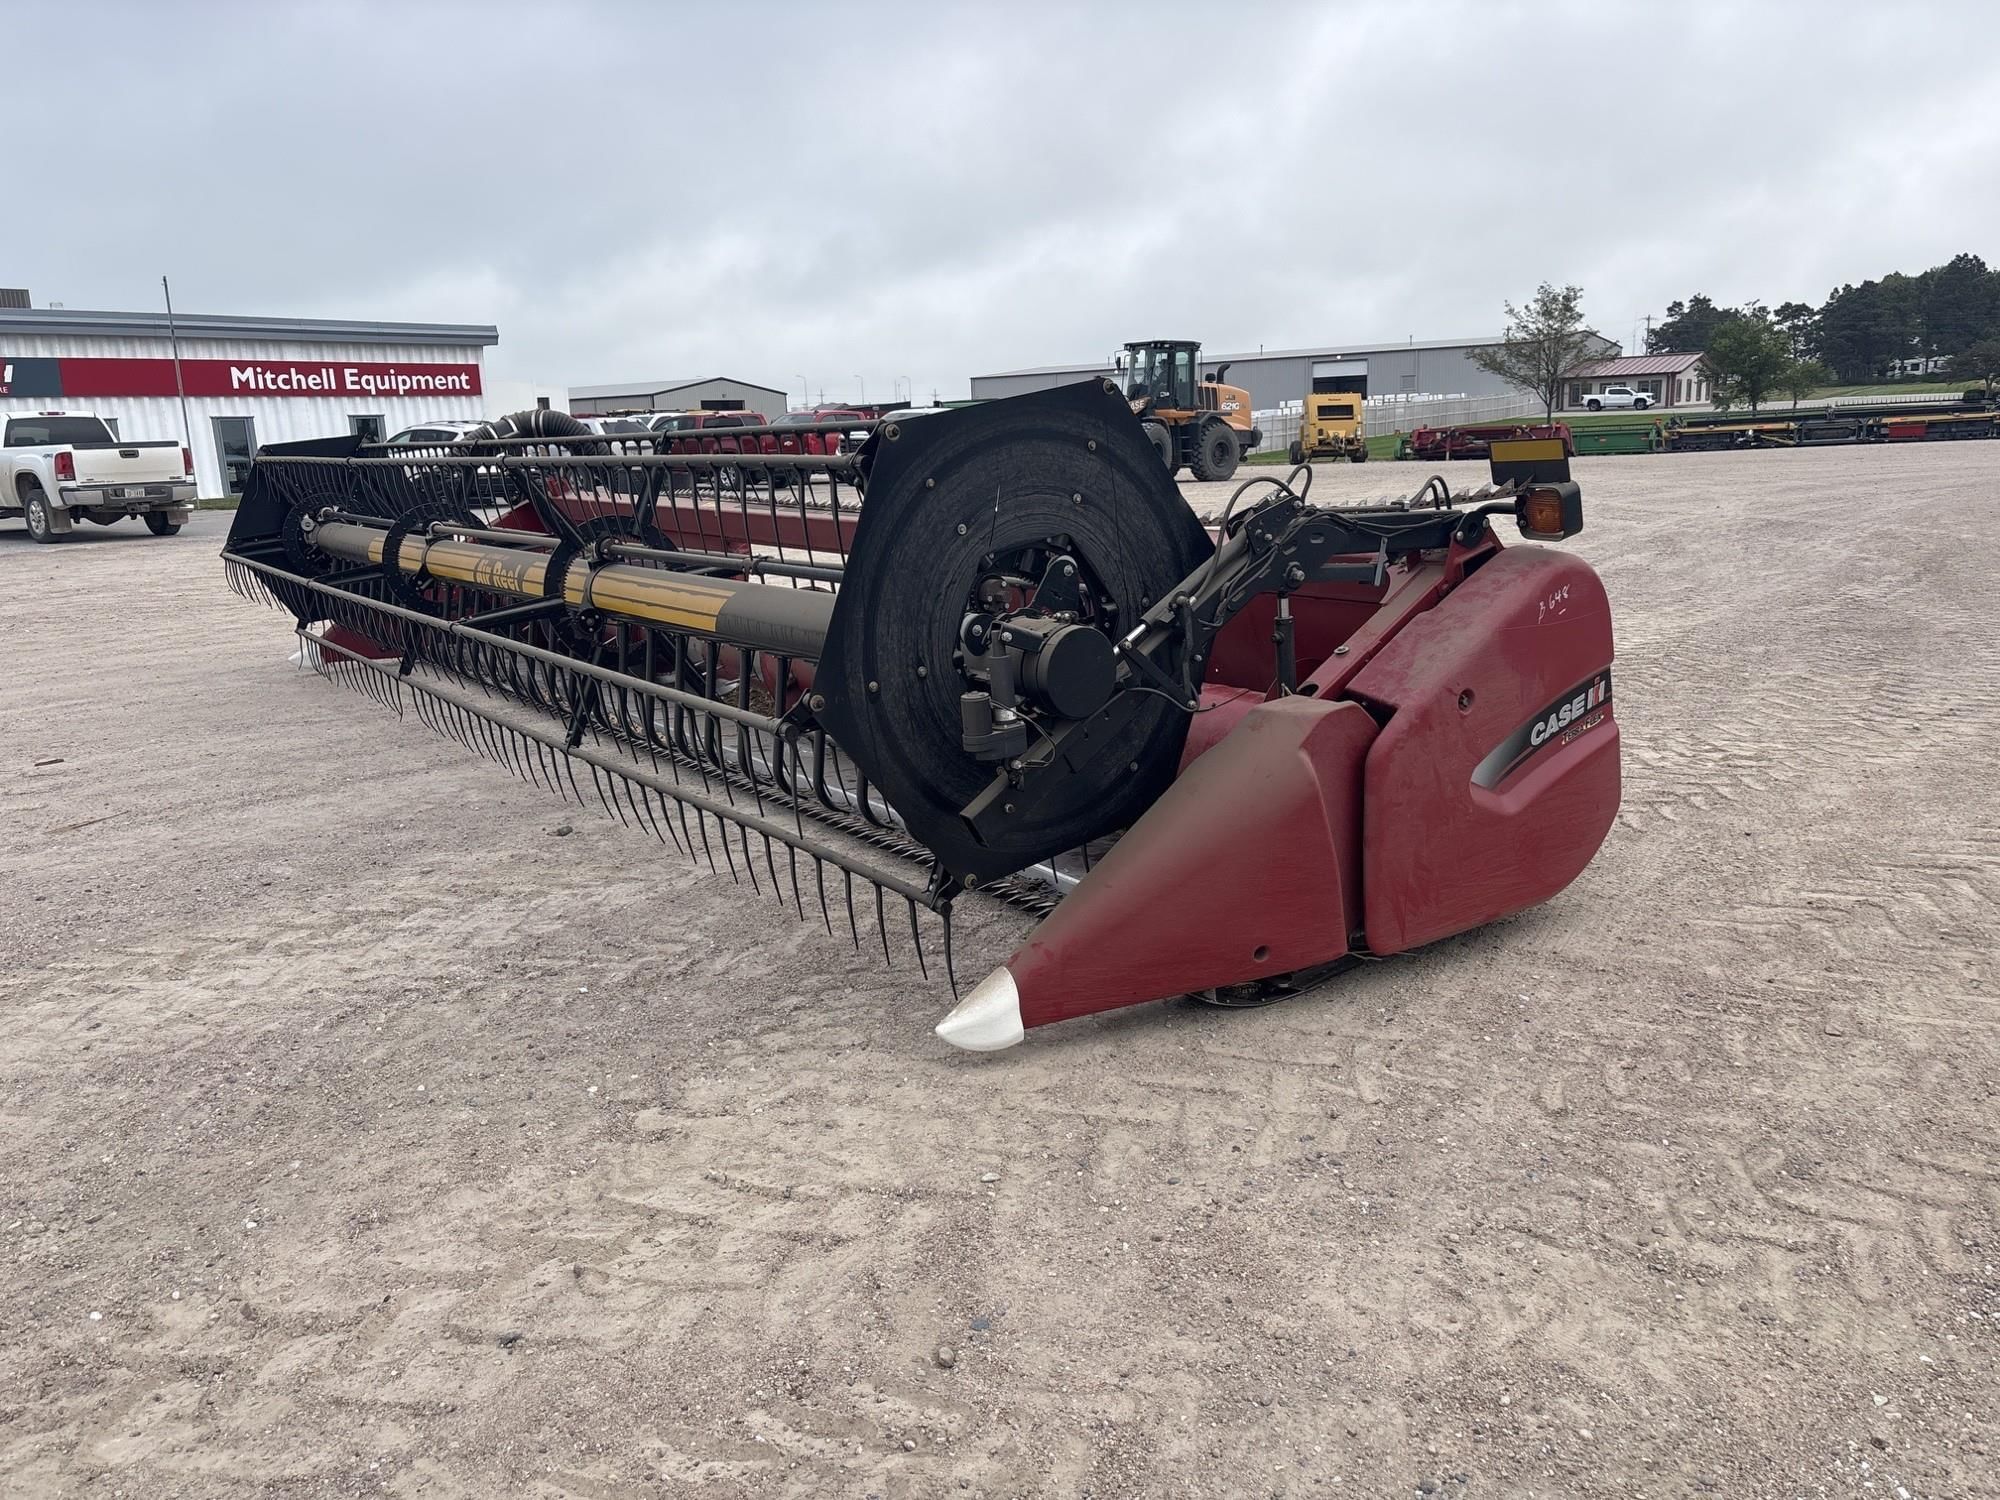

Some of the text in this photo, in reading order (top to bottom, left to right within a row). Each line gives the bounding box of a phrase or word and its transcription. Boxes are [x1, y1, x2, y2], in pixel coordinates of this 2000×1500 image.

[230, 366, 470, 395] Mitchell Equipment
[492, 559, 522, 592] Reel
[1530, 692, 1586, 746] CASE
